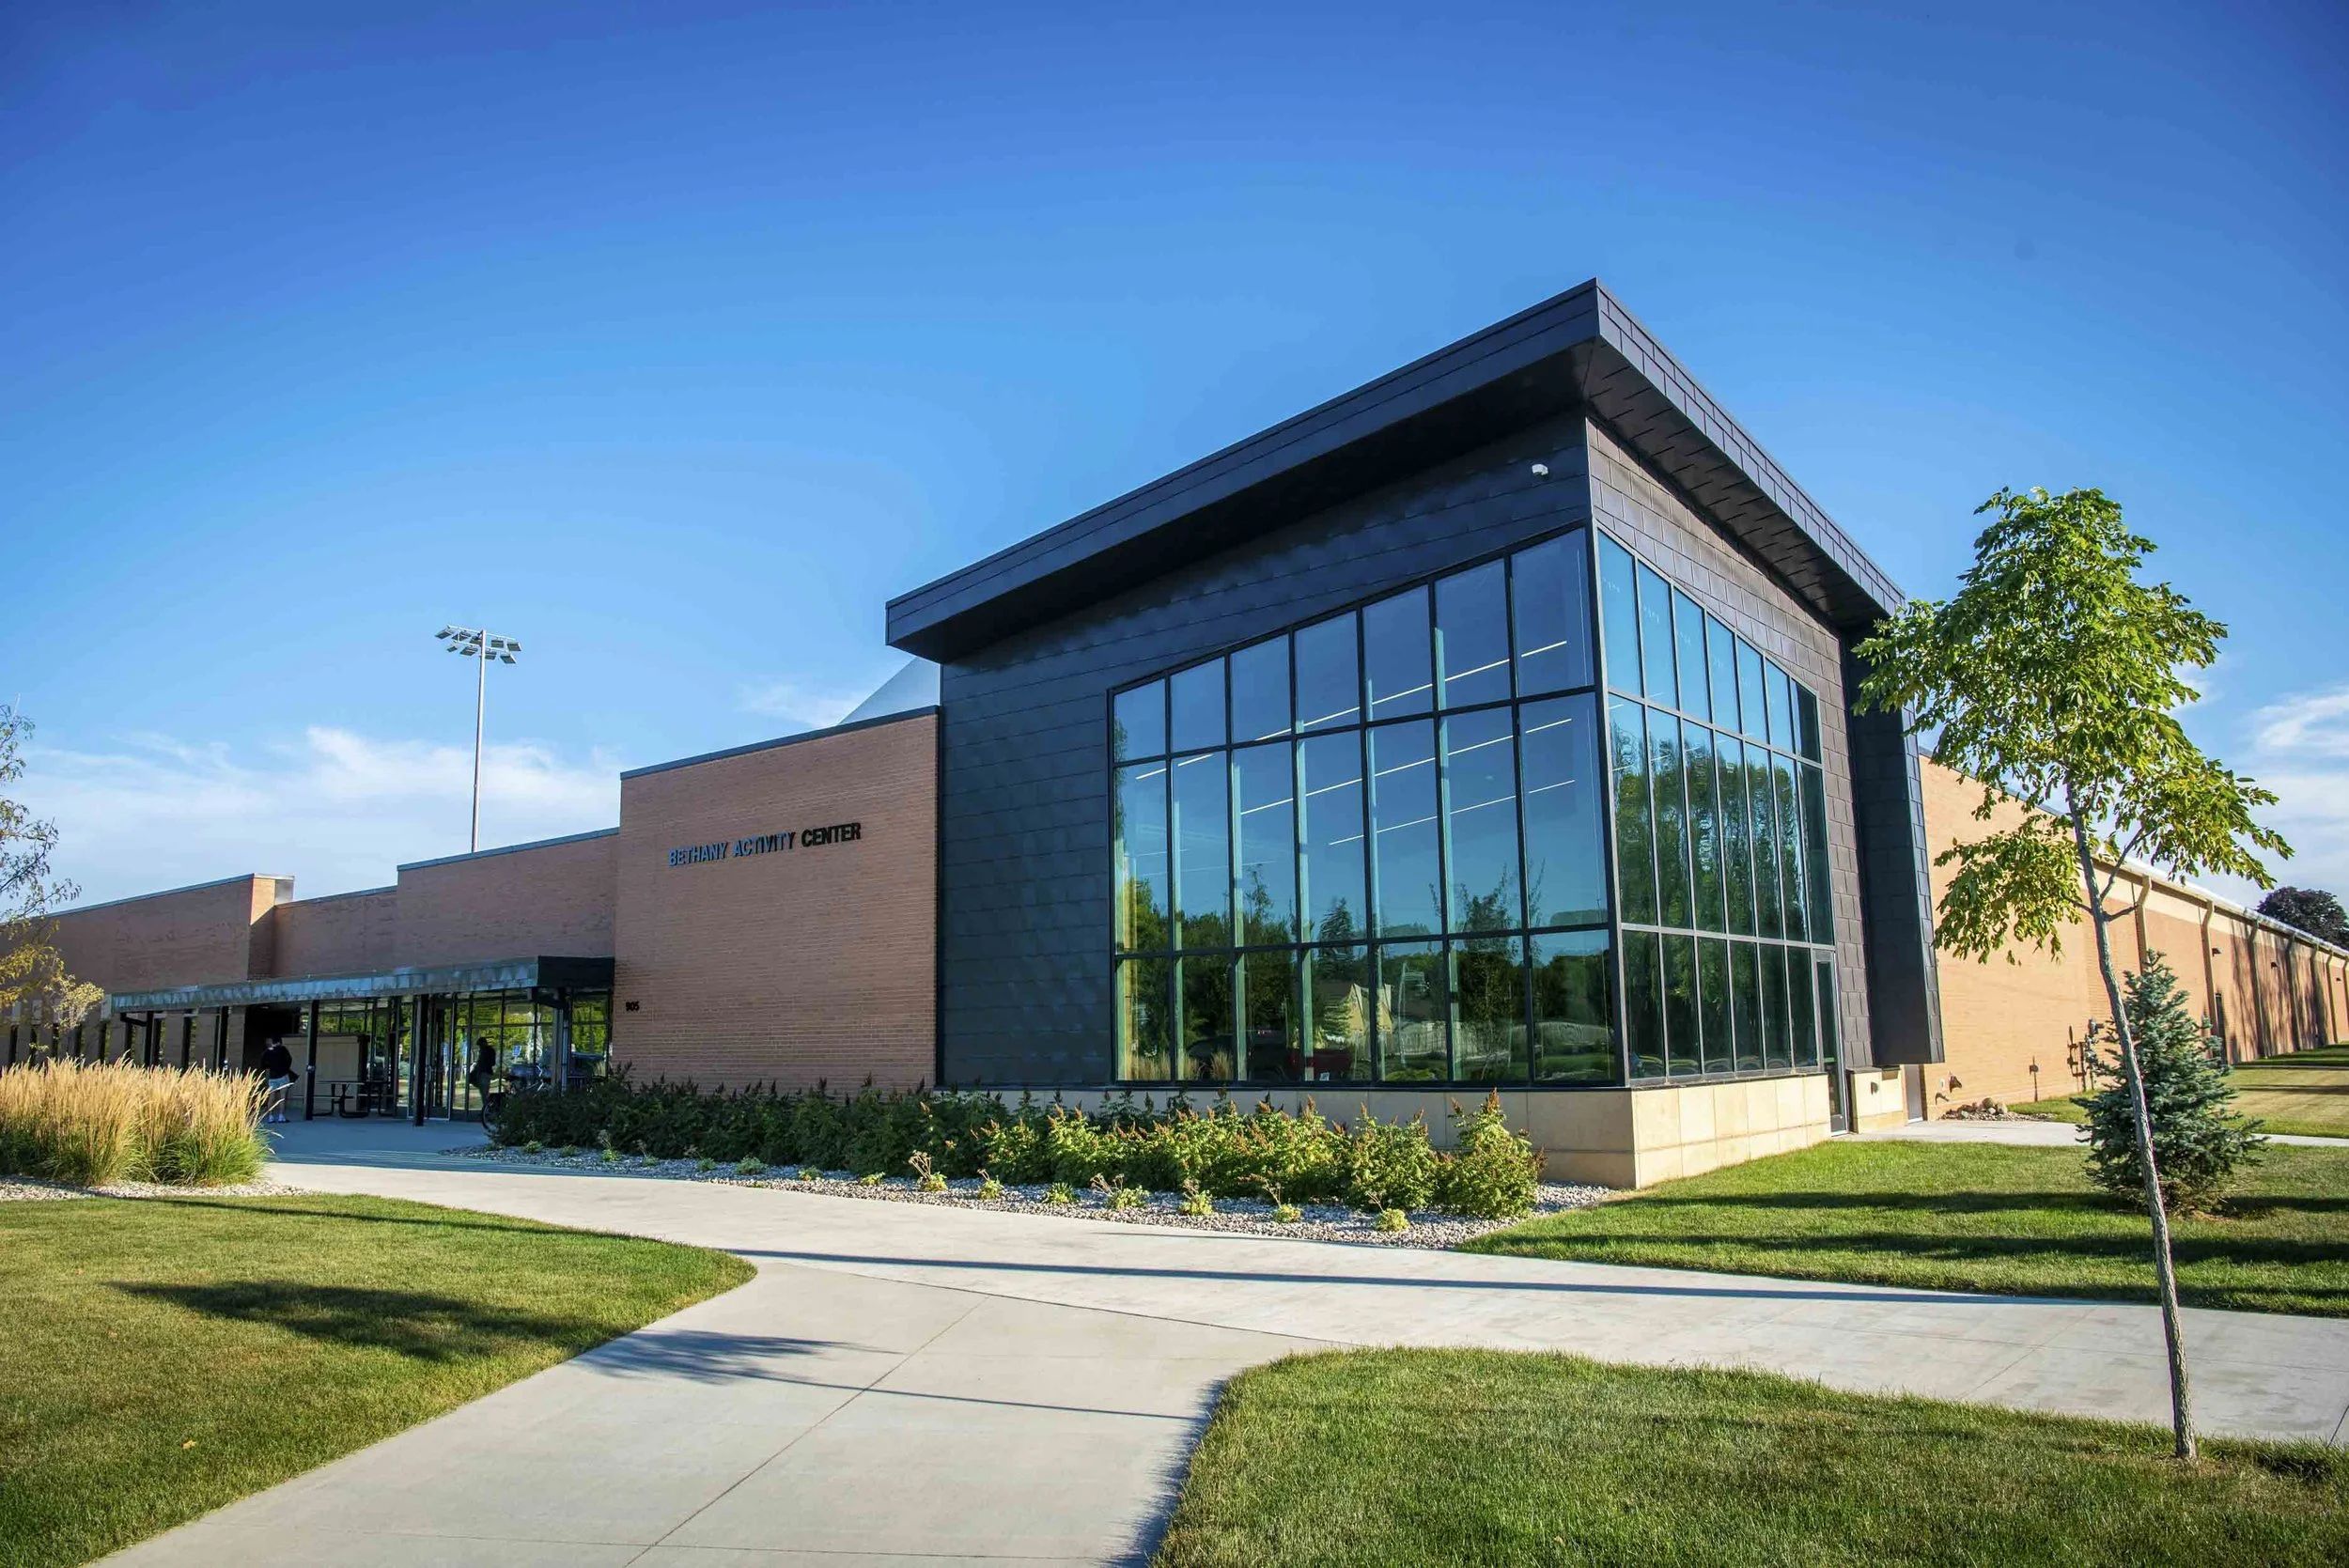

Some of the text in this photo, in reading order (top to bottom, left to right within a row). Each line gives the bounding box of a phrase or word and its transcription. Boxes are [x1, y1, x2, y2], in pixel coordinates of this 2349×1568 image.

[668, 822, 862, 866] BETHANY ACTIVITY CENTER
